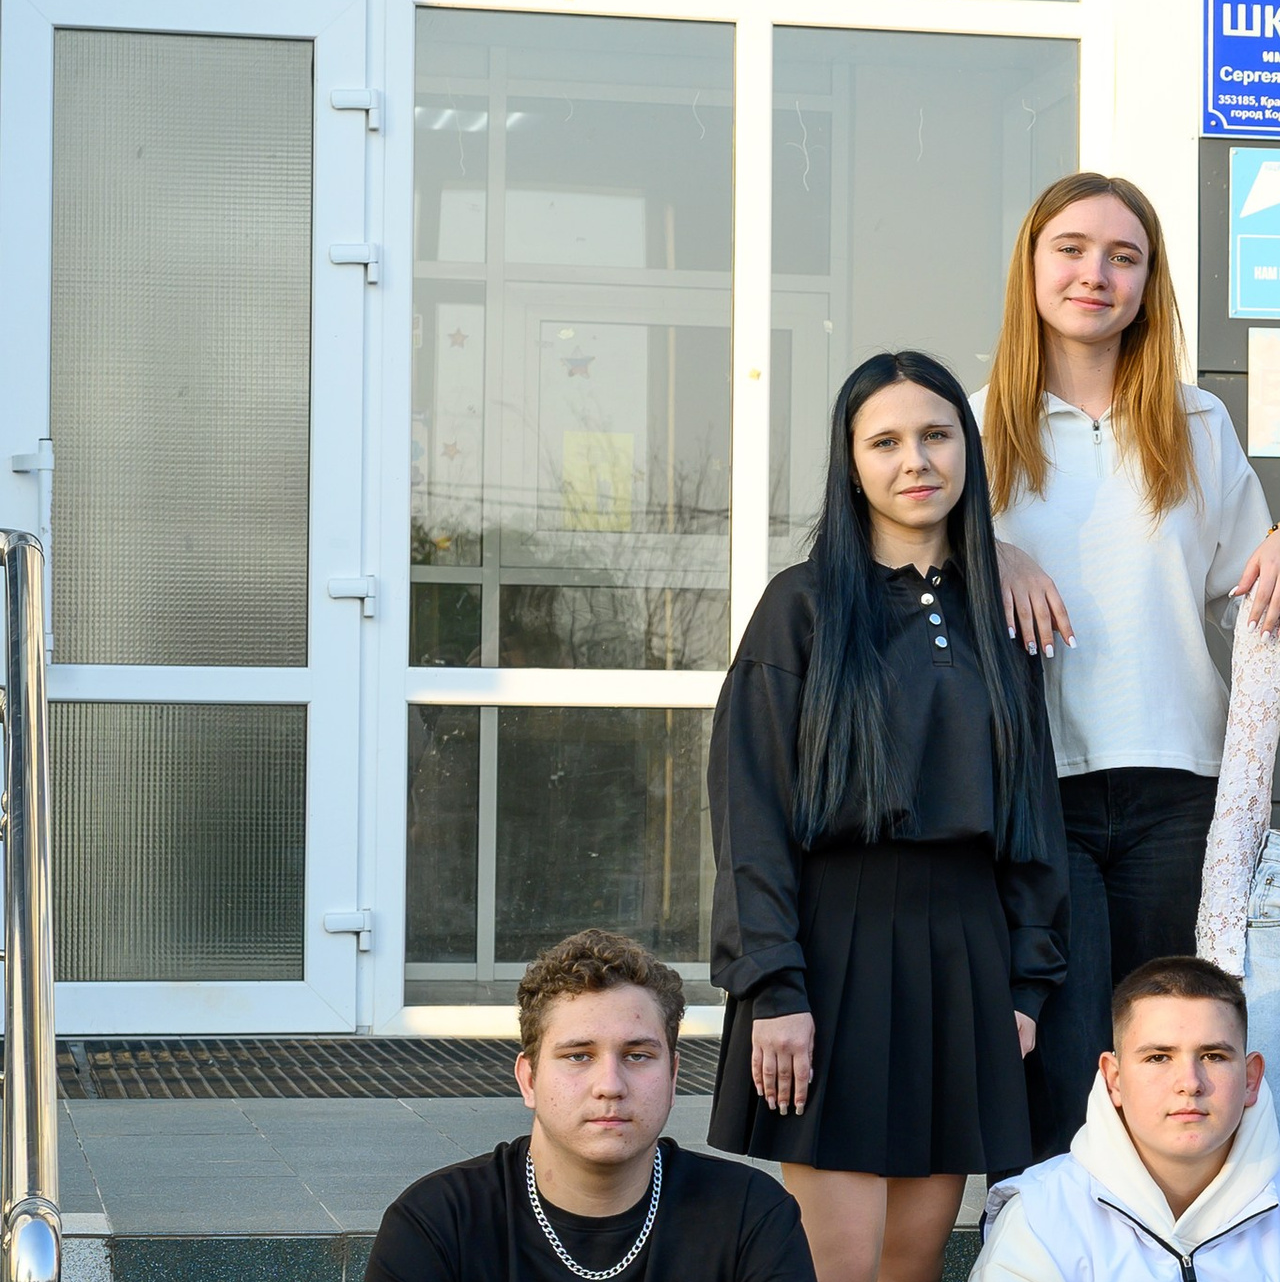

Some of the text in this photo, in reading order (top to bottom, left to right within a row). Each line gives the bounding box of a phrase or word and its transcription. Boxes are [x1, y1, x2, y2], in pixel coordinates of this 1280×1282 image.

[1218, 94, 1259, 107] 353185,
[1230, 108, 1263, 120] город
[1254, 266, 1278, 280] НАМ
